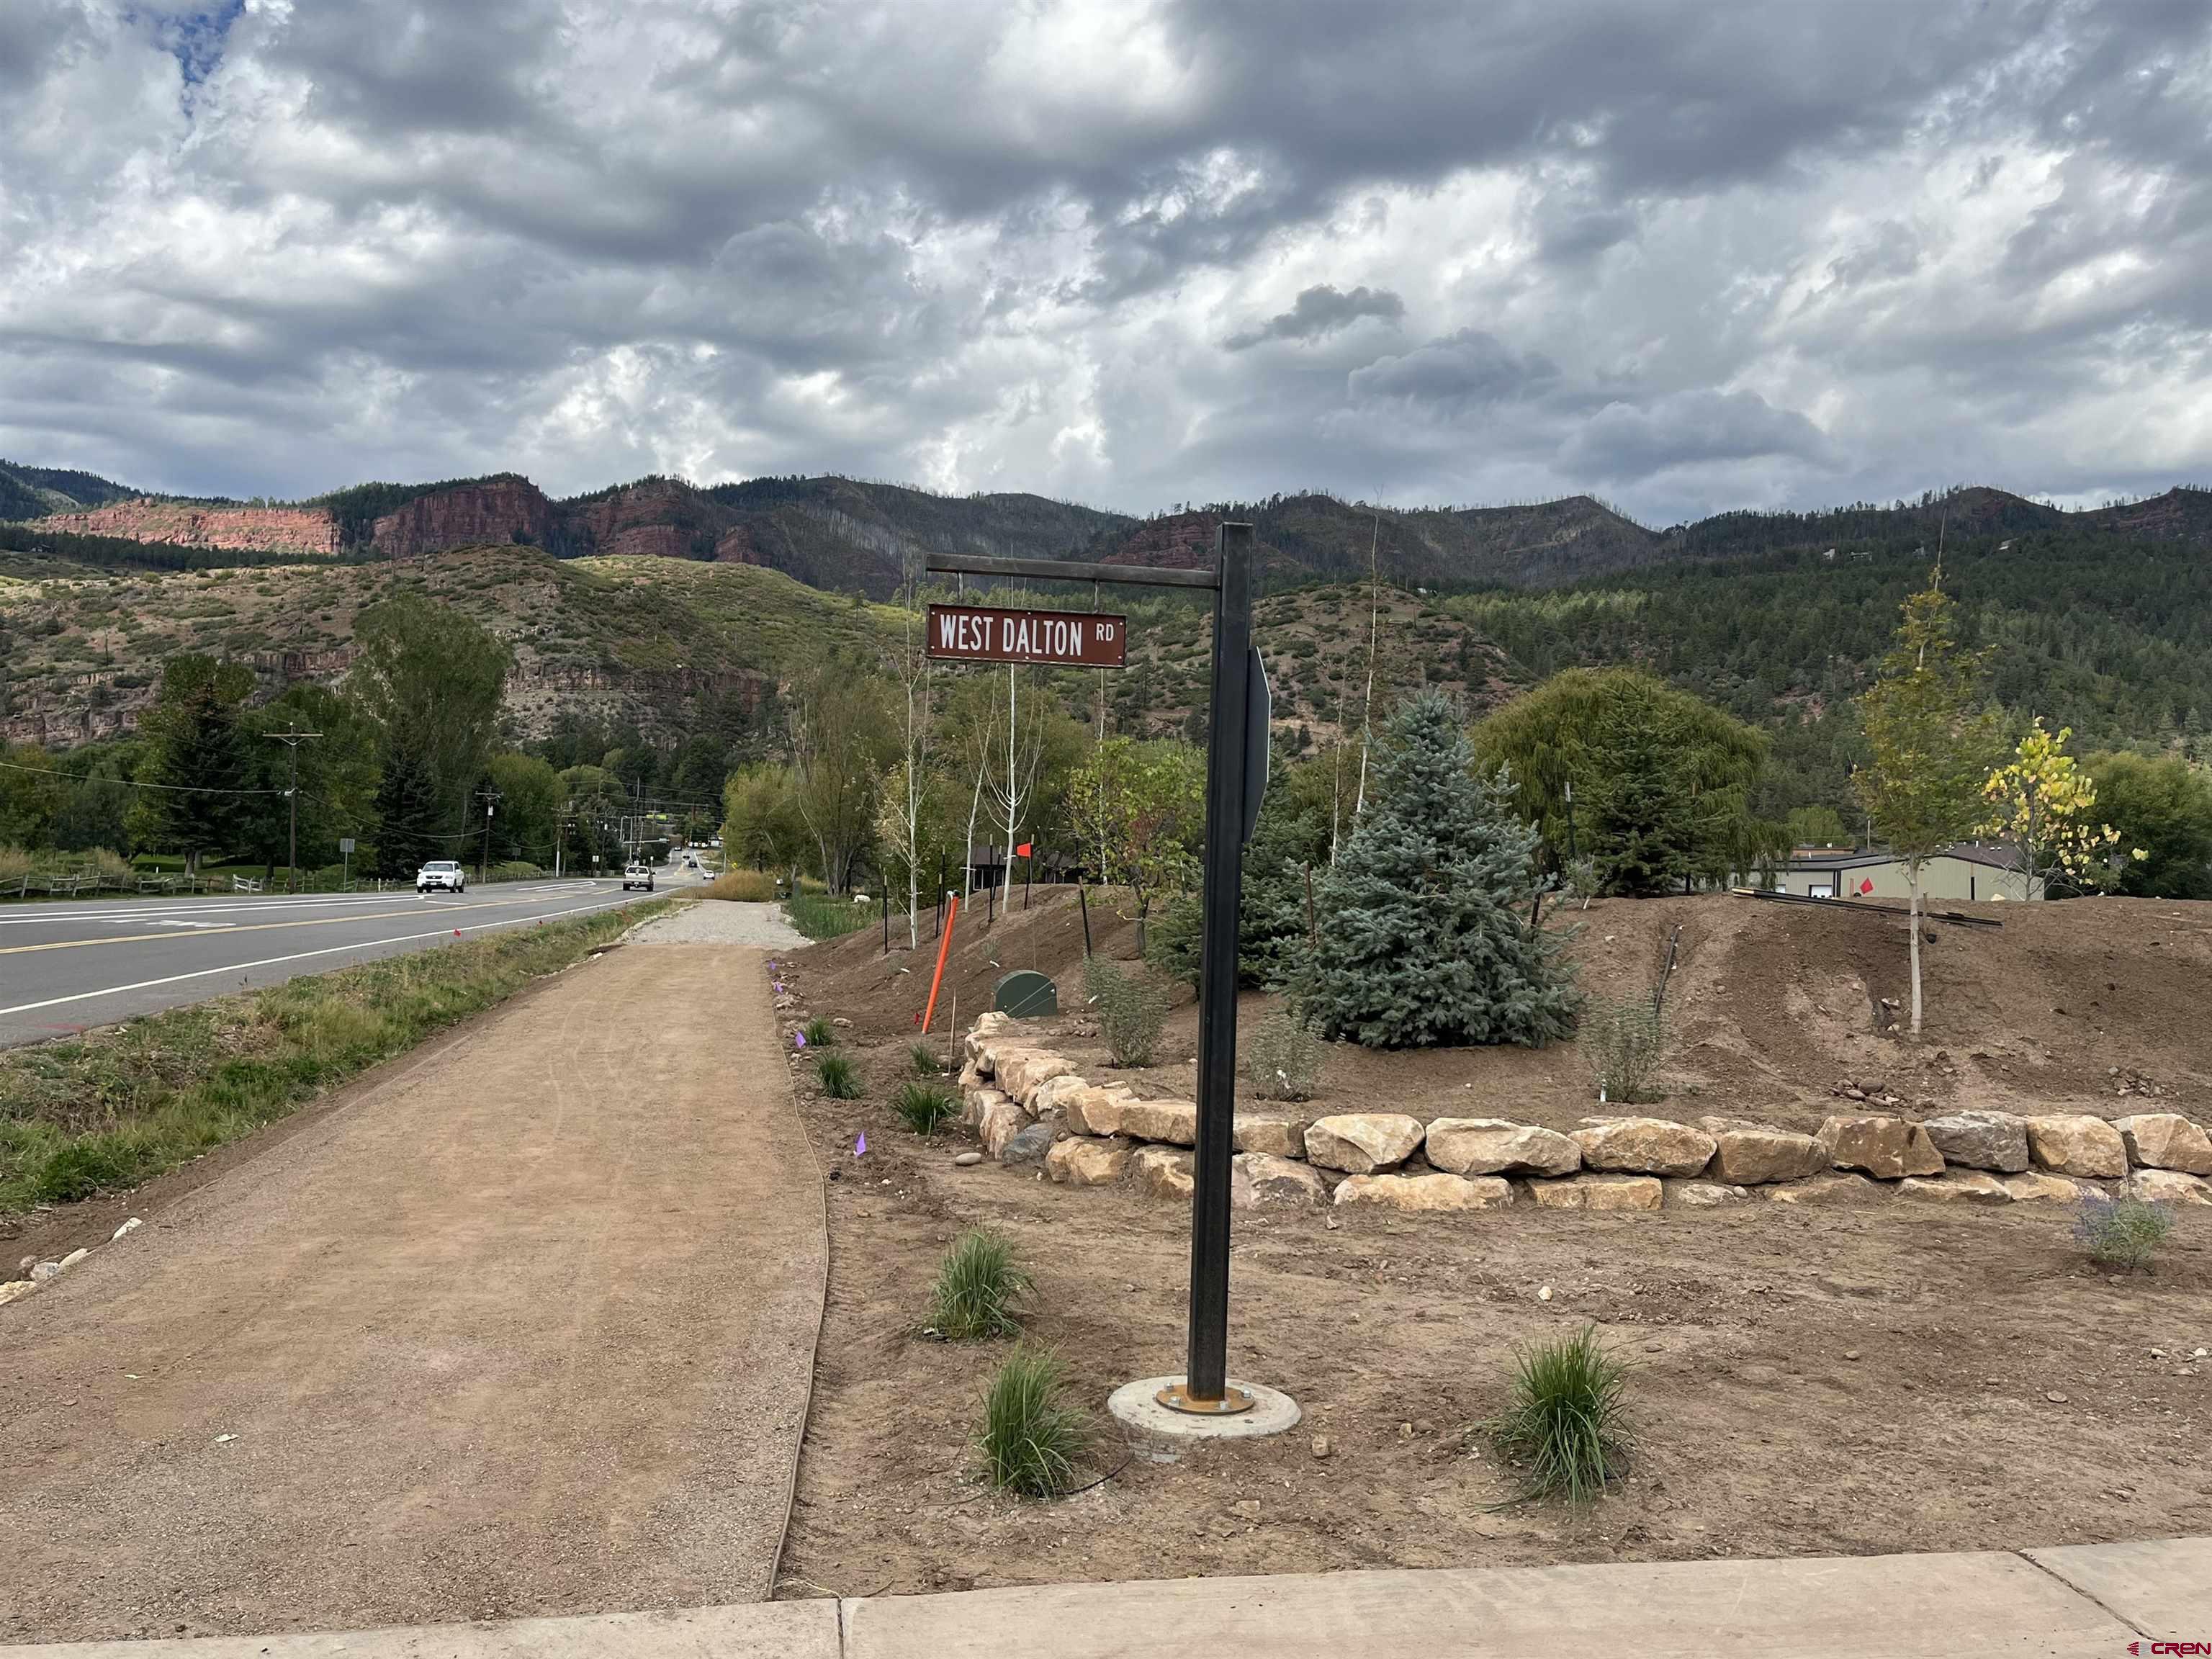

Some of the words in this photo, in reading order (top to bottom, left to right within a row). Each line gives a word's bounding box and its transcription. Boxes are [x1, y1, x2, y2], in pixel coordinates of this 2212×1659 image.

[940, 614, 994, 651] WEST
[1003, 618, 1082, 656] DALTON
[1095, 623, 1115, 642] RD
